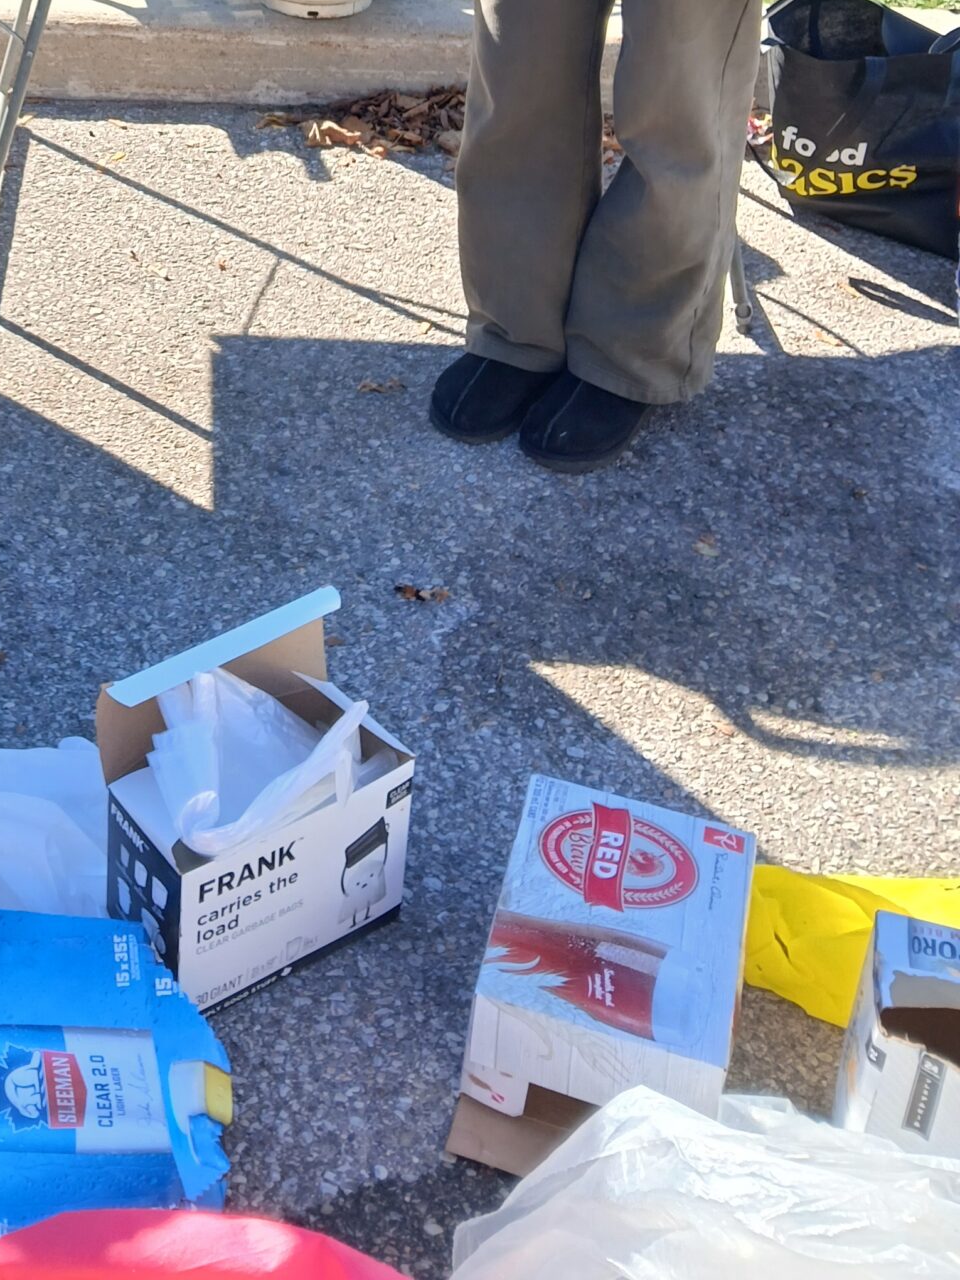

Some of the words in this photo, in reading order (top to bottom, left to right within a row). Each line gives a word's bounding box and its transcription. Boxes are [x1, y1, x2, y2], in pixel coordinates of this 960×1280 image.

[111, 802, 144, 853] FRANK
[198, 840, 297, 904] FRANK
[592, 830, 626, 880] RED
[197, 889, 262, 926] carries
[268, 872, 299, 894] the
[195, 935, 230, 955] CLEAR
[231, 913, 277, 940] GARBAGE
[278, 899, 304, 918] BAGS
[196, 914, 239, 944] load
[115, 972, 131, 988] 15
[154, 977, 173, 997] 15
[210, 974, 244, 1000] GIANT
[89, 1054, 108, 1077] 2.0
[110, 1067, 124, 1092] LAGER
[51, 1056, 78, 1124] SLEEMAN
[94, 1083, 114, 1128] CLEAR
[115, 1094, 127, 1117] LIGHT
